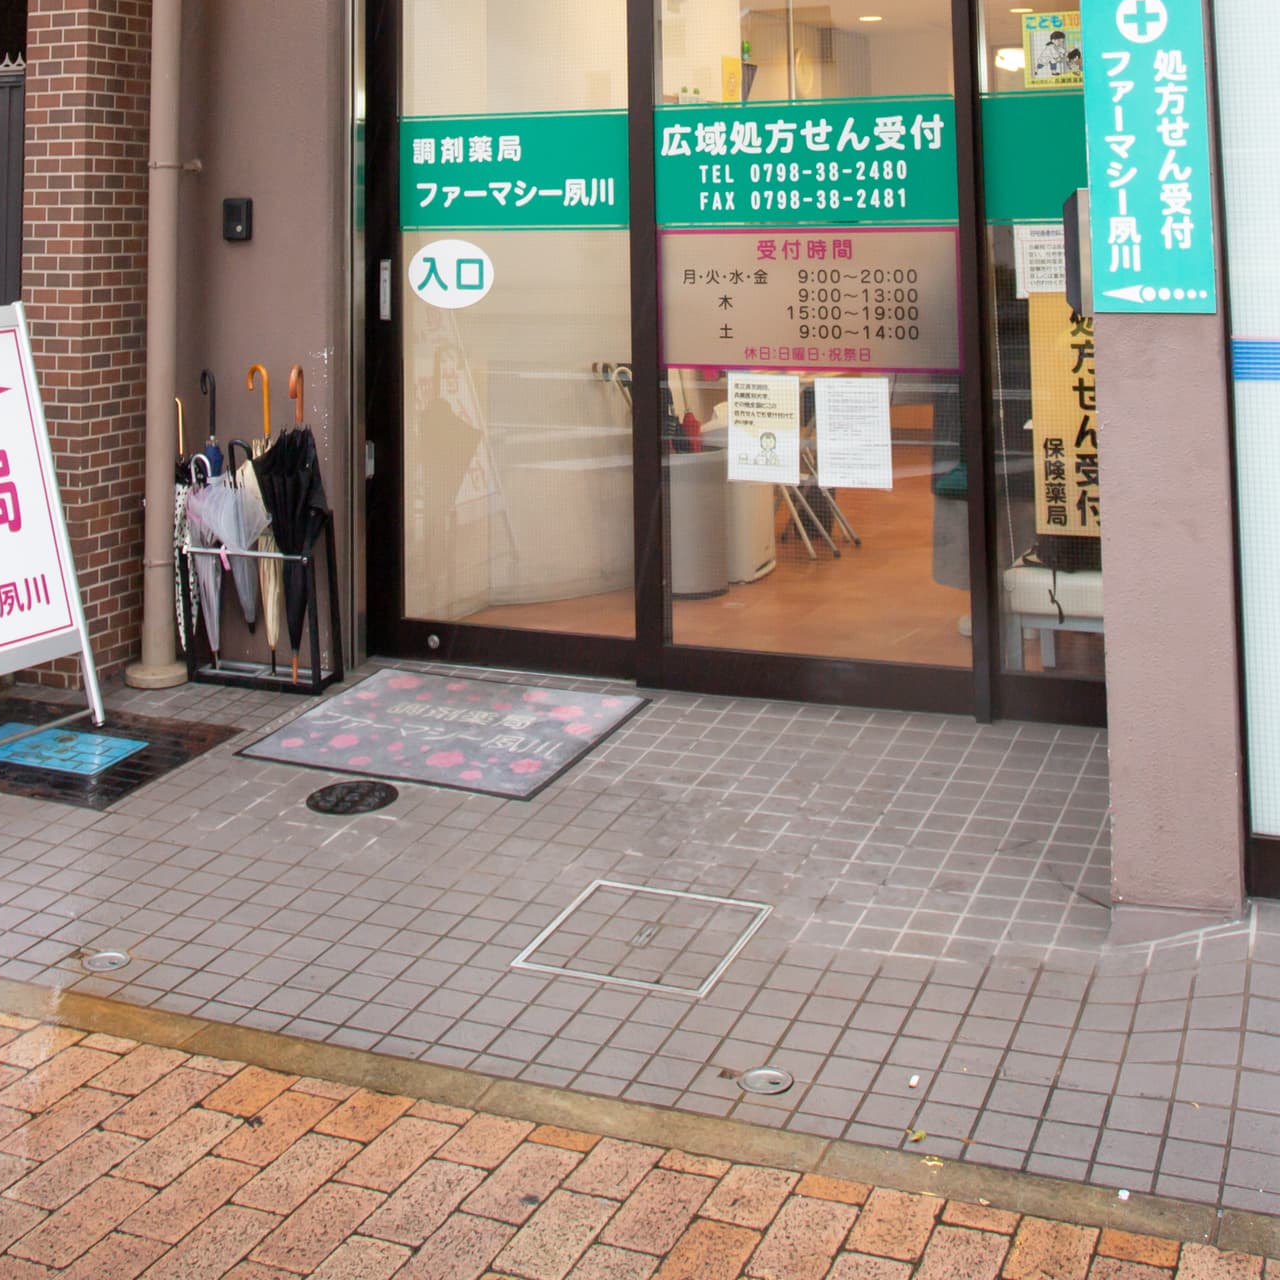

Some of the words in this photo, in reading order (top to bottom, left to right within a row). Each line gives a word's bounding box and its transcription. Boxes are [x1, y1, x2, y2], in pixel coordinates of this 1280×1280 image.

[412, 135, 522, 165] 調剤薬局
[660, 114, 946, 157] 広域処方せん受付
[1153, 49, 1195, 250] 処方せん受付
[699, 164, 735, 185] TEL
[750, 159, 908, 184] 0798-38-2480
[1101, 51, 1142, 273] ファーマシー夙川
[416, 177, 615, 208] ファーマシー夙川
[699, 191, 736, 212] FAX
[750, 188, 907, 211] 0798-38-2481
[756, 239, 853, 261] 受付時間
[417, 256, 485, 293] 入口
[719, 294, 734, 311] 木
[719, 323, 734, 339] 土
[1043, 438, 1068, 526] 保険薬局
